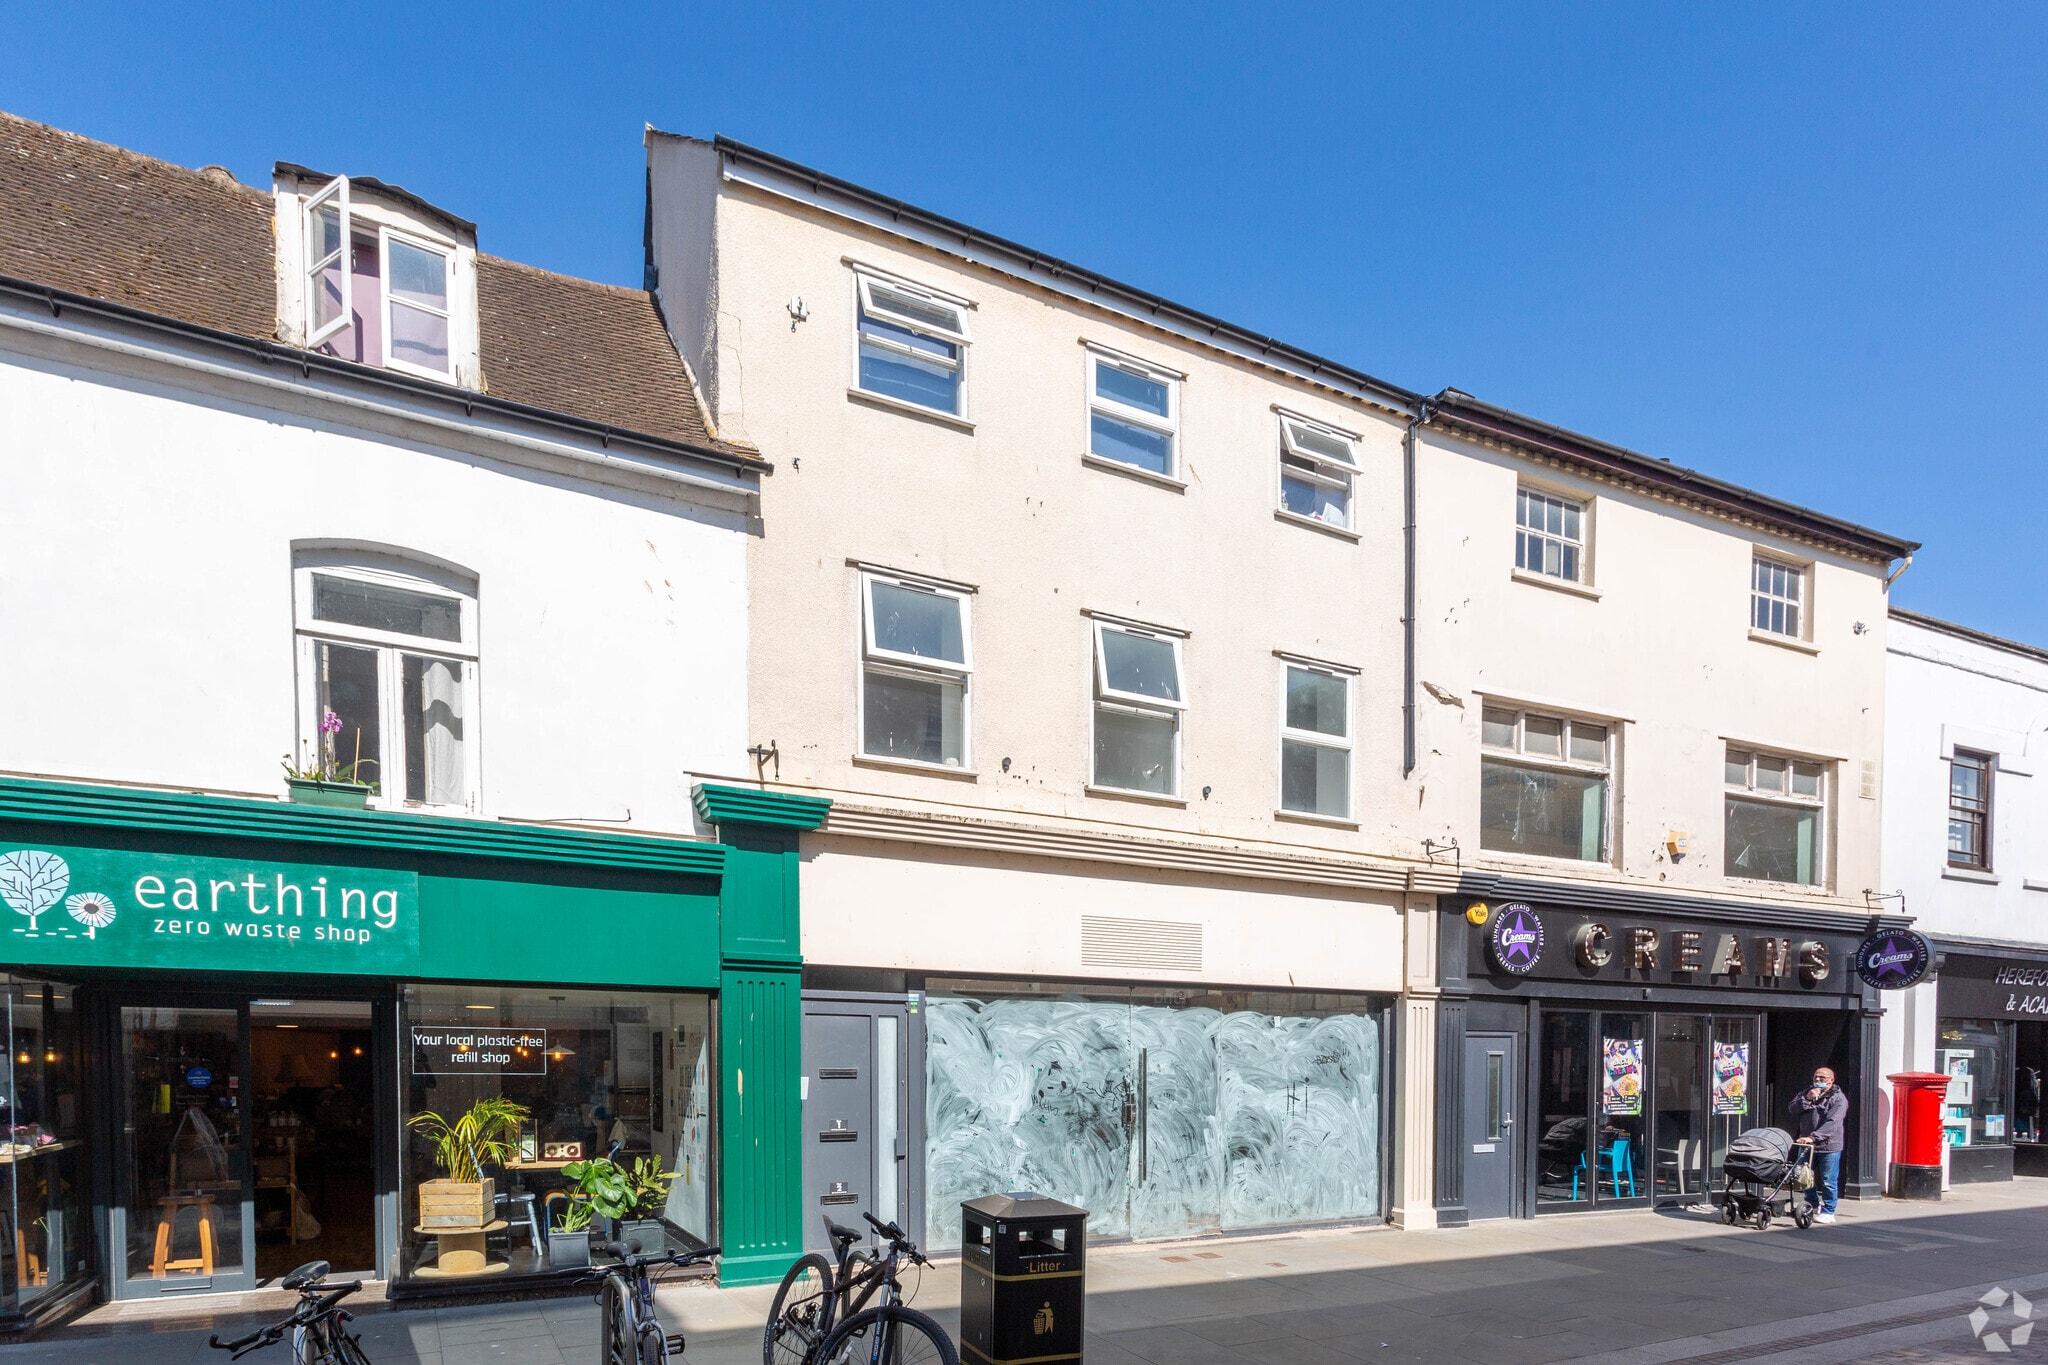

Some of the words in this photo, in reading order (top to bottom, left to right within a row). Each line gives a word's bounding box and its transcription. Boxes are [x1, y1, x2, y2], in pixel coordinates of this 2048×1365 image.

[134, 873, 398, 929] earthing
[1509, 904, 1530, 912] GELATO
[1474, 909, 1487, 918] Yale
[153, 918, 211, 935] zero
[223, 921, 301, 939] waste
[314, 923, 371, 945] shop
[1493, 913, 1505, 943] SUNDAES
[1501, 927, 1536, 946] Creams
[1534, 914, 1545, 946] WAFFLES
[1876, 930, 1904, 938] GELATO
[1575, 922, 1830, 980] CREAMS
[1858, 941, 1871, 968] SUNDAES
[1911, 935, 1926, 962] WAFFLES
[1521, 954, 1540, 973] COFFEE
[1868, 952, 1913, 969] Creams
[1896, 969, 1921, 987] COFFEE
[1995, 966, 2048, 987] HEREFO
[2006, 993, 2017, 1011] &
[413, 1034, 443, 1046] Your
[446, 1034, 474, 1046] local
[477, 1035, 543, 1048] plastic-free
[451, 1052, 478, 1063] refill
[481, 1052, 511, 1065] shop
[1030, 1261, 1062, 1273] Litter
